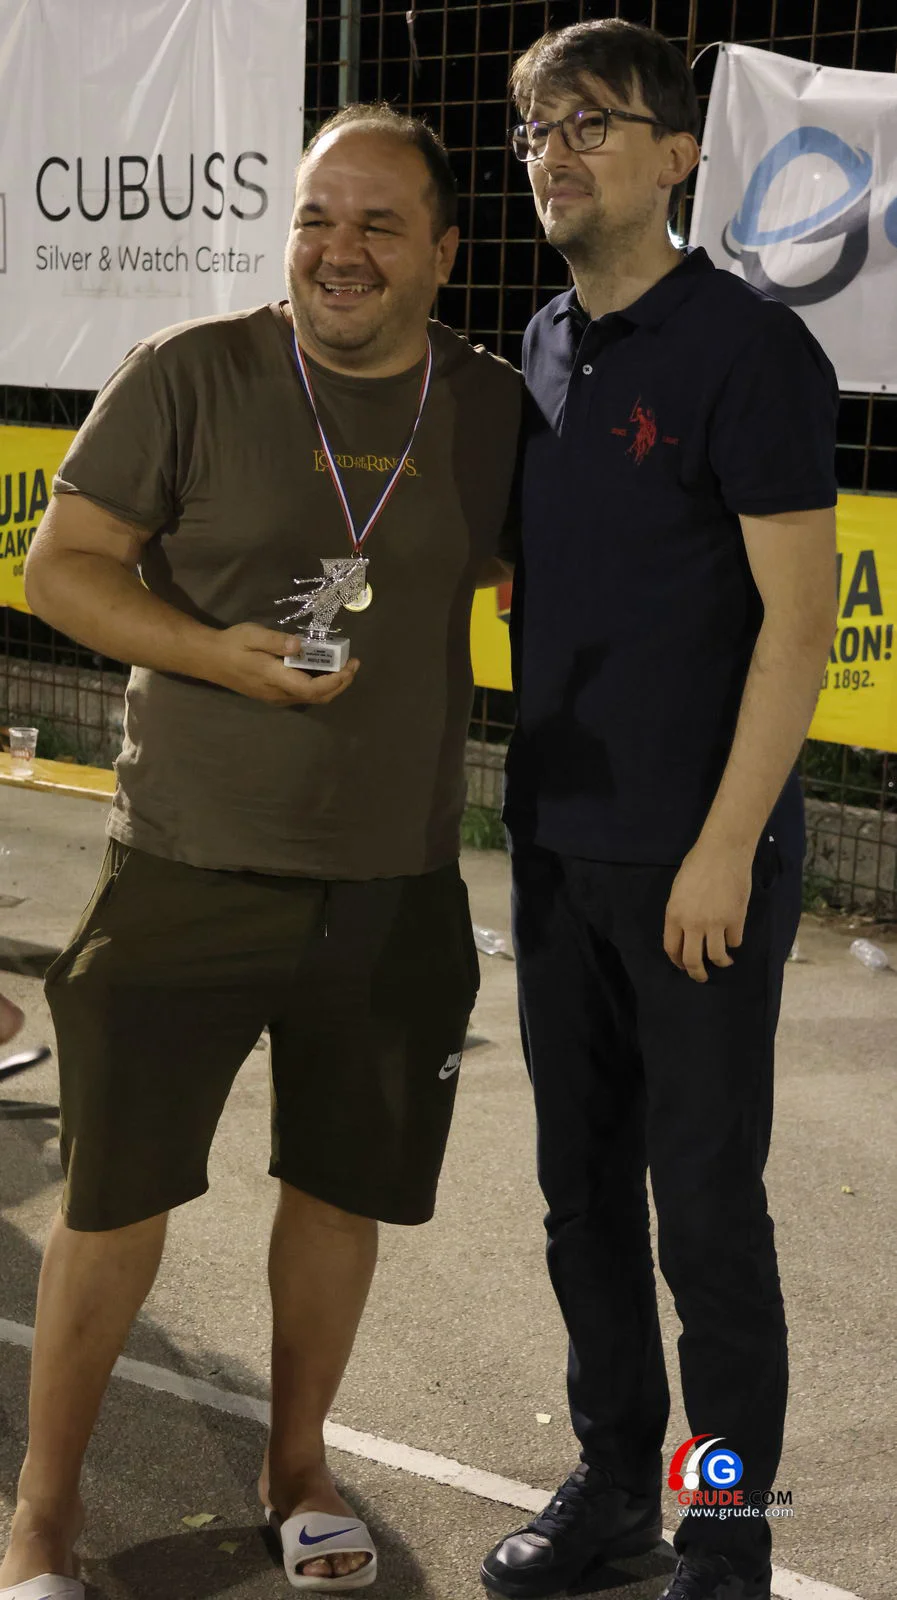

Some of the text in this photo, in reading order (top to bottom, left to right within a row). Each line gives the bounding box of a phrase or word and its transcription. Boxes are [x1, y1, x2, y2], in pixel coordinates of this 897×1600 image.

[36, 151, 268, 222] CUBUSS
[36, 244, 92, 271] Silver
[98, 245, 112, 272] &
[118, 244, 189, 272] Watch
[836, 549, 883, 619] A
[830, 624, 893, 664] ON!
[834, 668, 875, 691] 1892.
